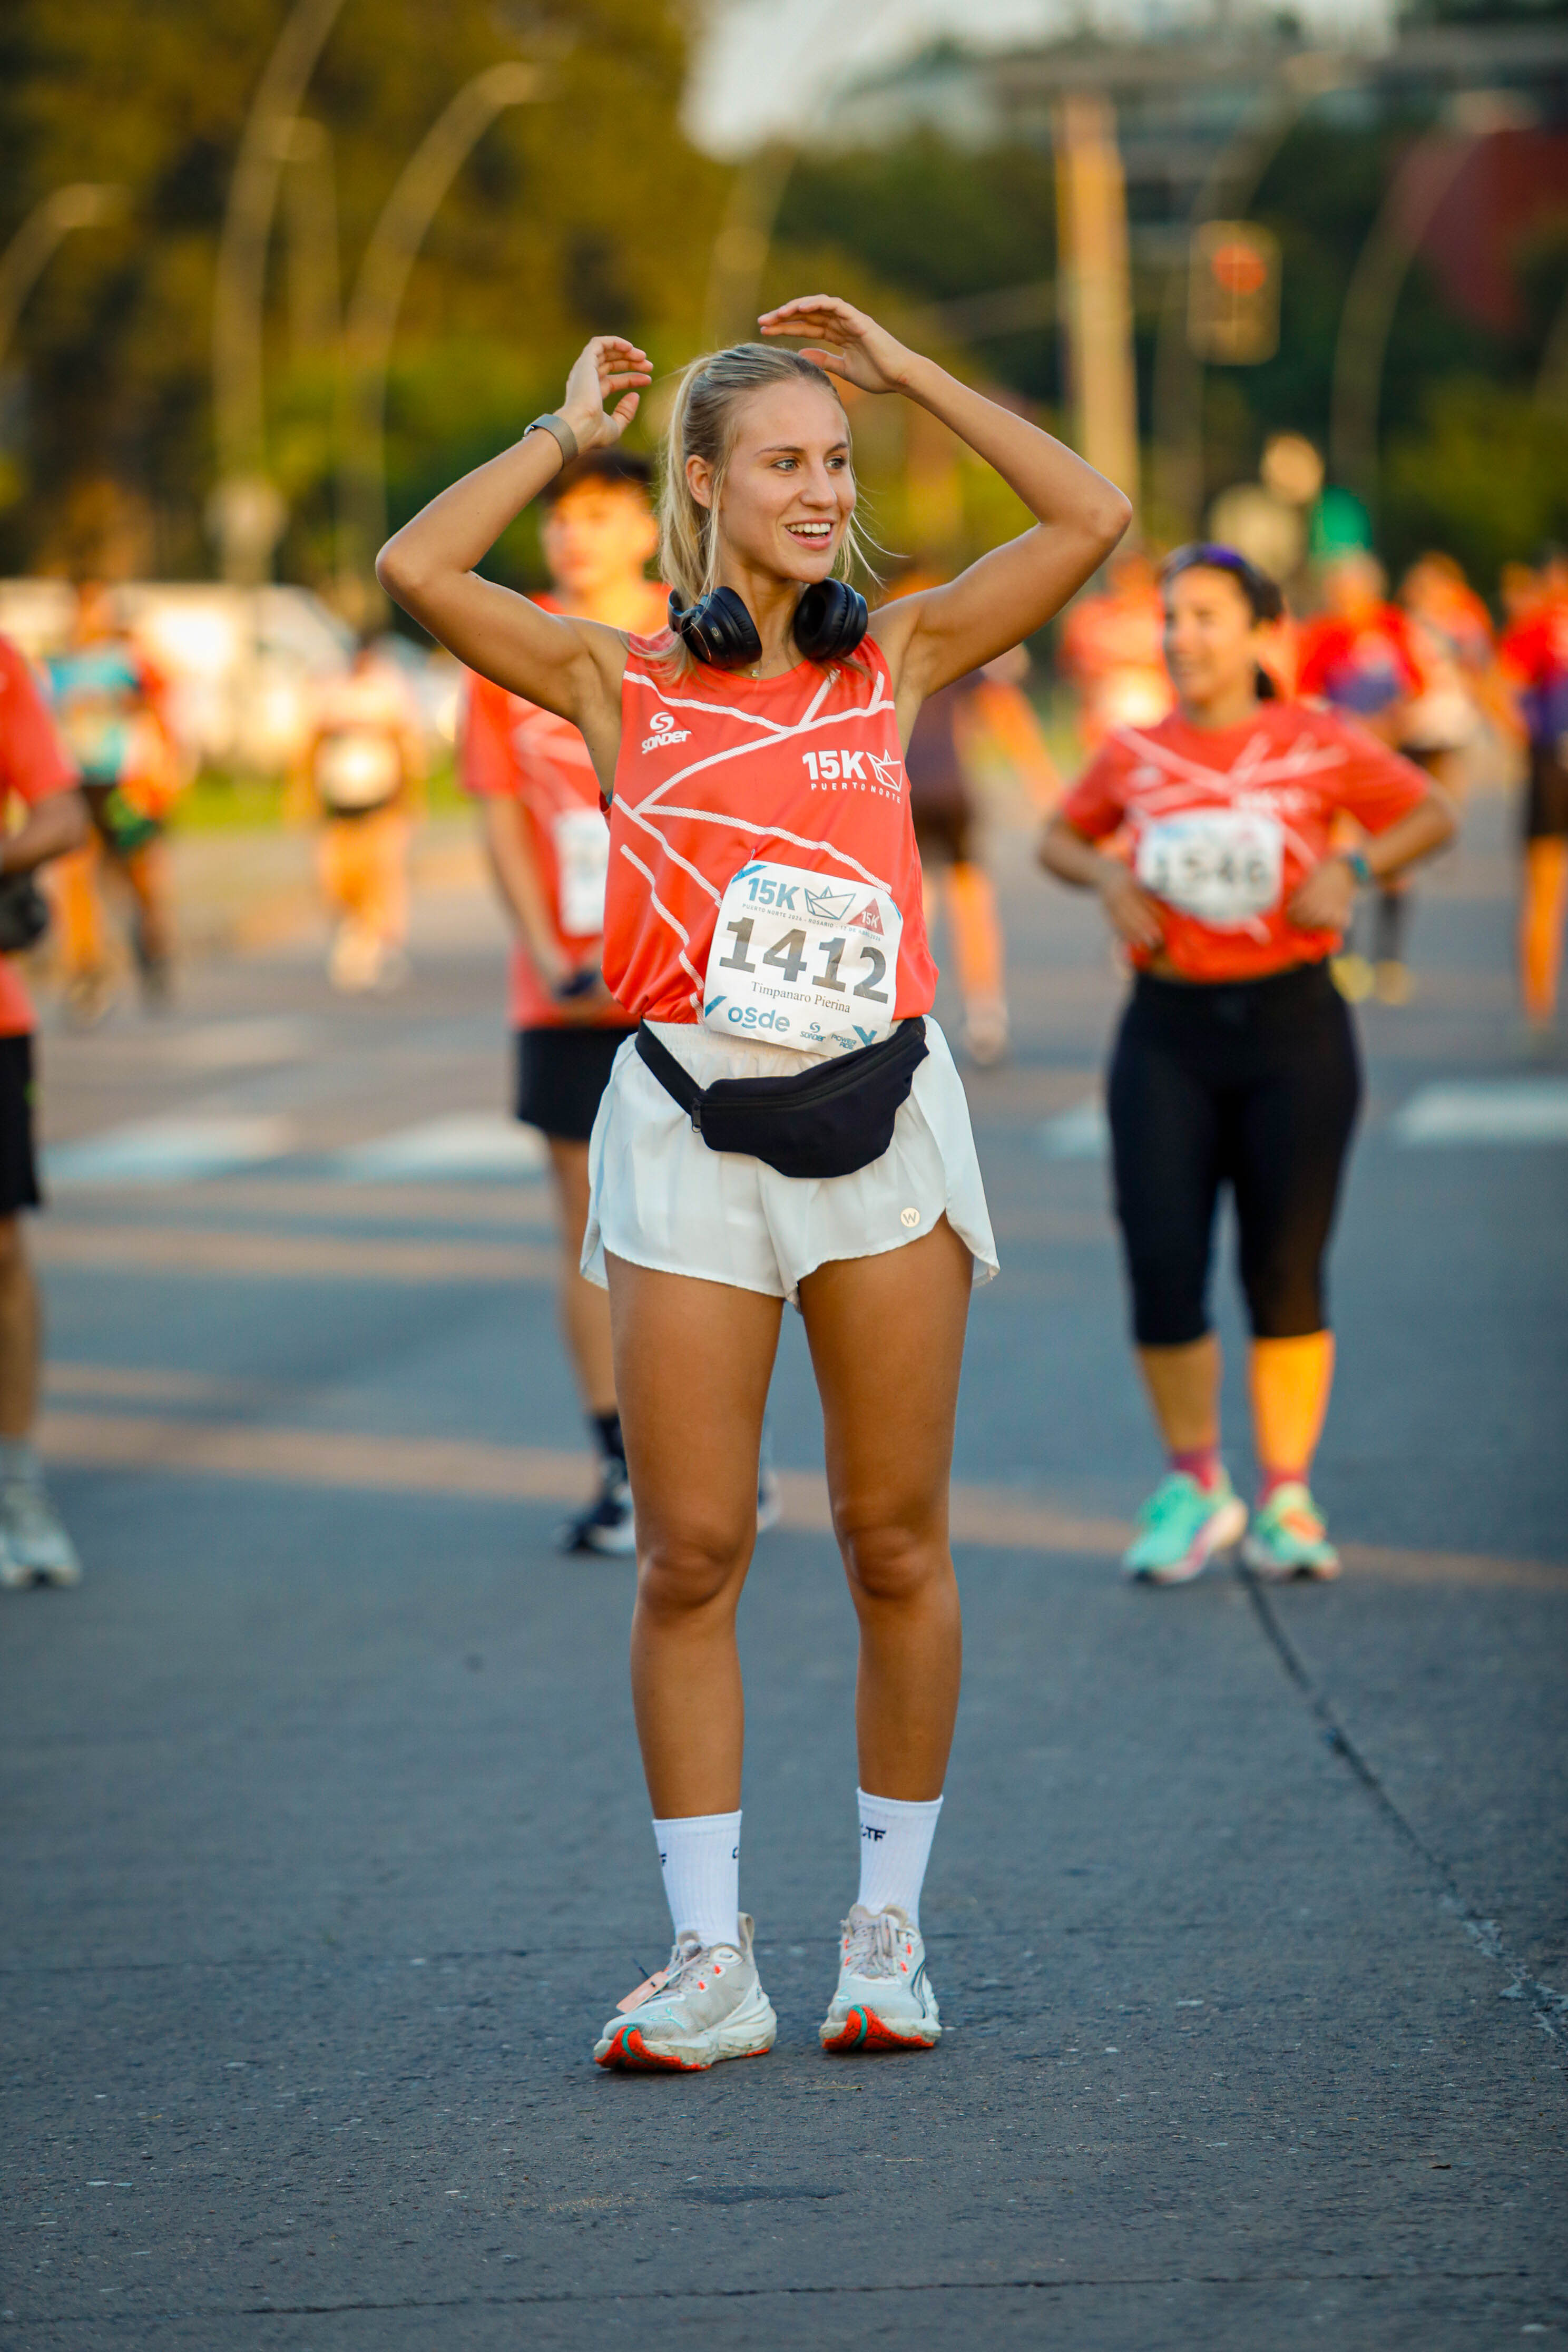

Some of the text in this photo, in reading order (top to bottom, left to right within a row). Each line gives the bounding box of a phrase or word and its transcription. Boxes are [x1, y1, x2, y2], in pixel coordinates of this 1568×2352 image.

[802, 750, 867, 780] 15K
[811, 782, 901, 803] PUERTO NORTE
[748, 877, 800, 910] 15K
[742, 903, 766, 913] PUERTO
[767, 909, 787, 918] NORTE
[809, 918, 834, 928] ROSARIO
[861, 910, 879, 928] 15K
[719, 917, 889, 1004] 1412
[751, 982, 850, 1013] Timpanaro Pierina
[728, 1006, 790, 1032] osde
[831, 1034, 857, 1045] POWER
